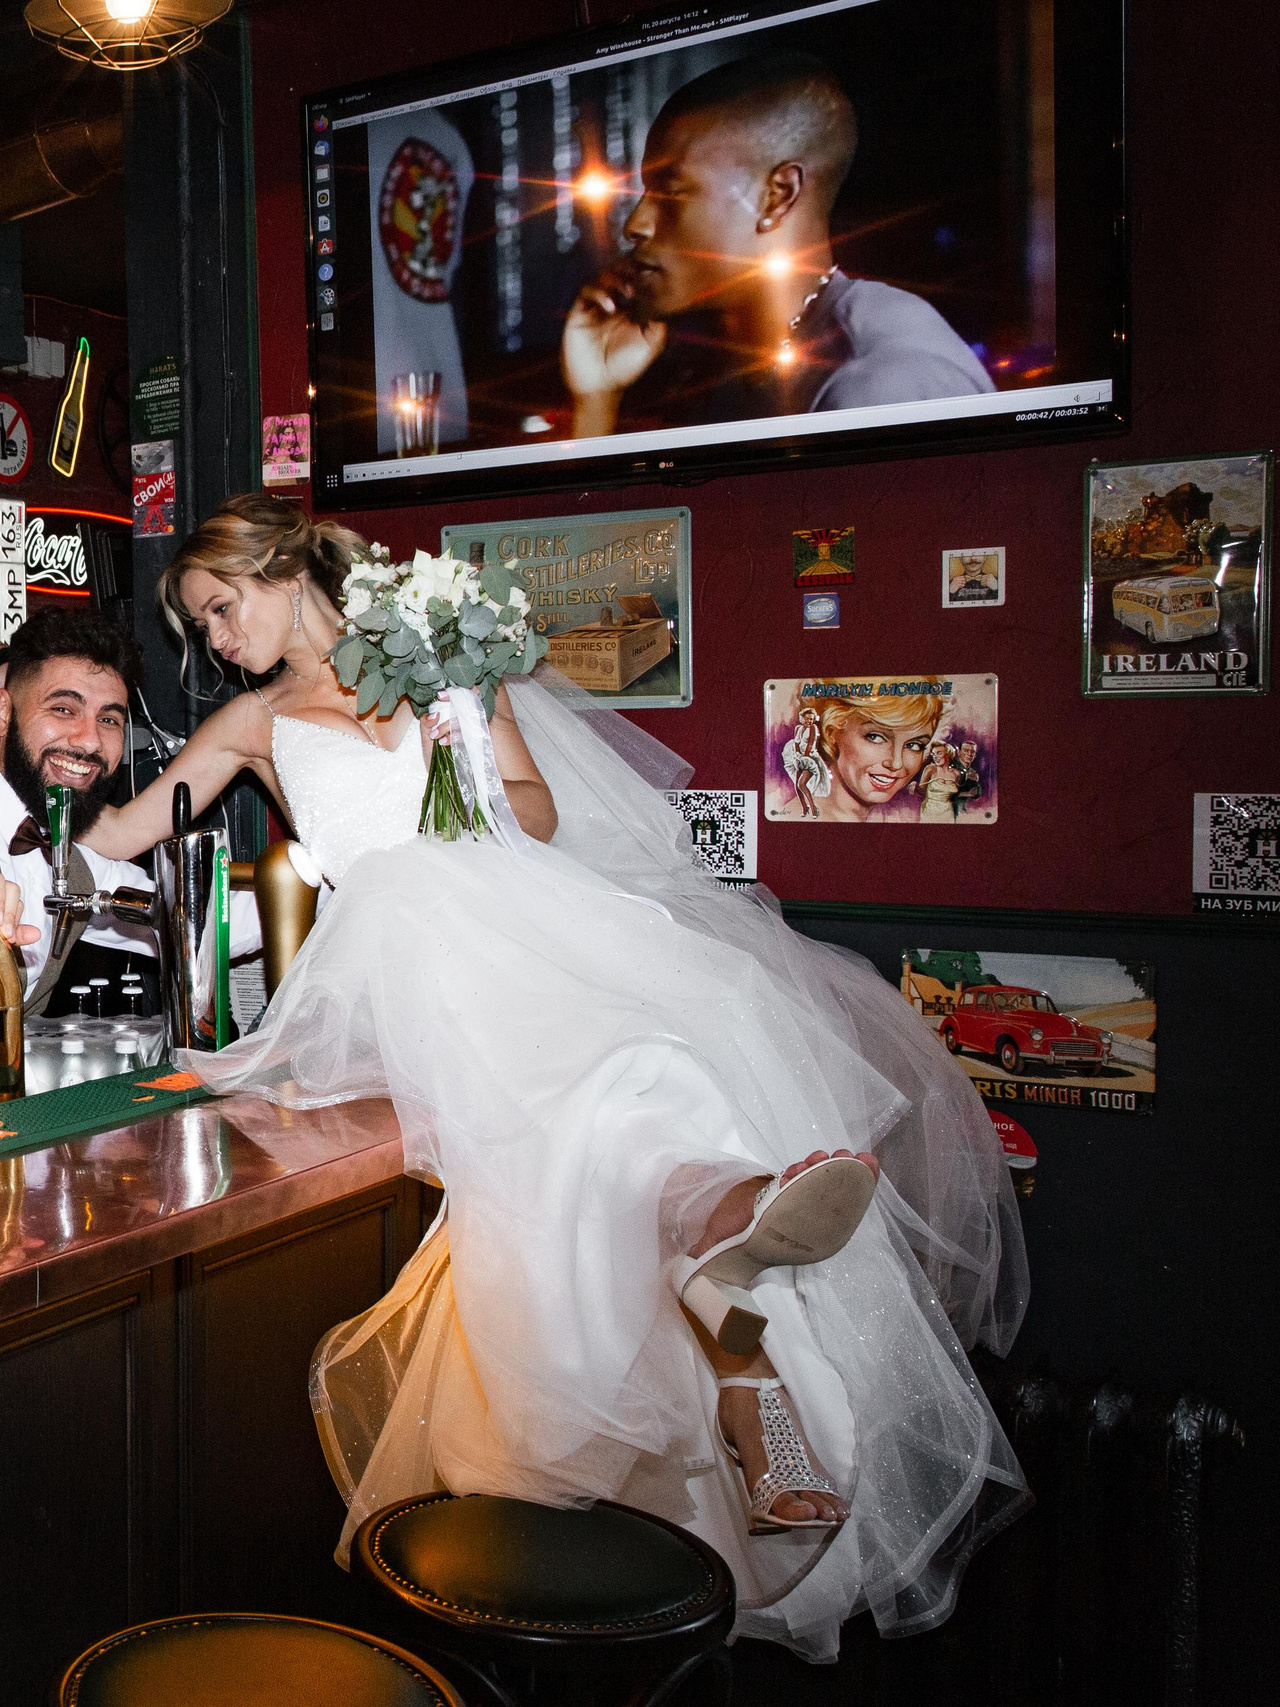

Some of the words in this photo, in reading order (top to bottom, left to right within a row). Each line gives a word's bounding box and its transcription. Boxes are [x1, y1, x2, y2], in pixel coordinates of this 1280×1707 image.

[646, 30, 674, 42] Stronger
[675, 26, 690, 36] Than
[1015, 411, 1049, 422] 00:00:42
[1055, 407, 1089, 418] 00:03:52
[1, 511, 16, 559] 163
[498, 534, 570, 562] CORK
[520, 535, 638, 591] STILLERIES
[550, 642, 603, 652] DISTILLERIES
[631, 639, 657, 658] IRELAND
[1102, 651, 1249, 673] IRELAND
[802, 683, 872, 698] MARILYN
[879, 682, 953, 696] MONROE
[1201, 898, 1222, 910] НА
[1225, 899, 1253, 911] ЗУБ
[975, 1081, 1018, 1098] RIS
[1023, 1084, 1082, 1106] MINOR
[1089, 1090, 1136, 1111] 1000
